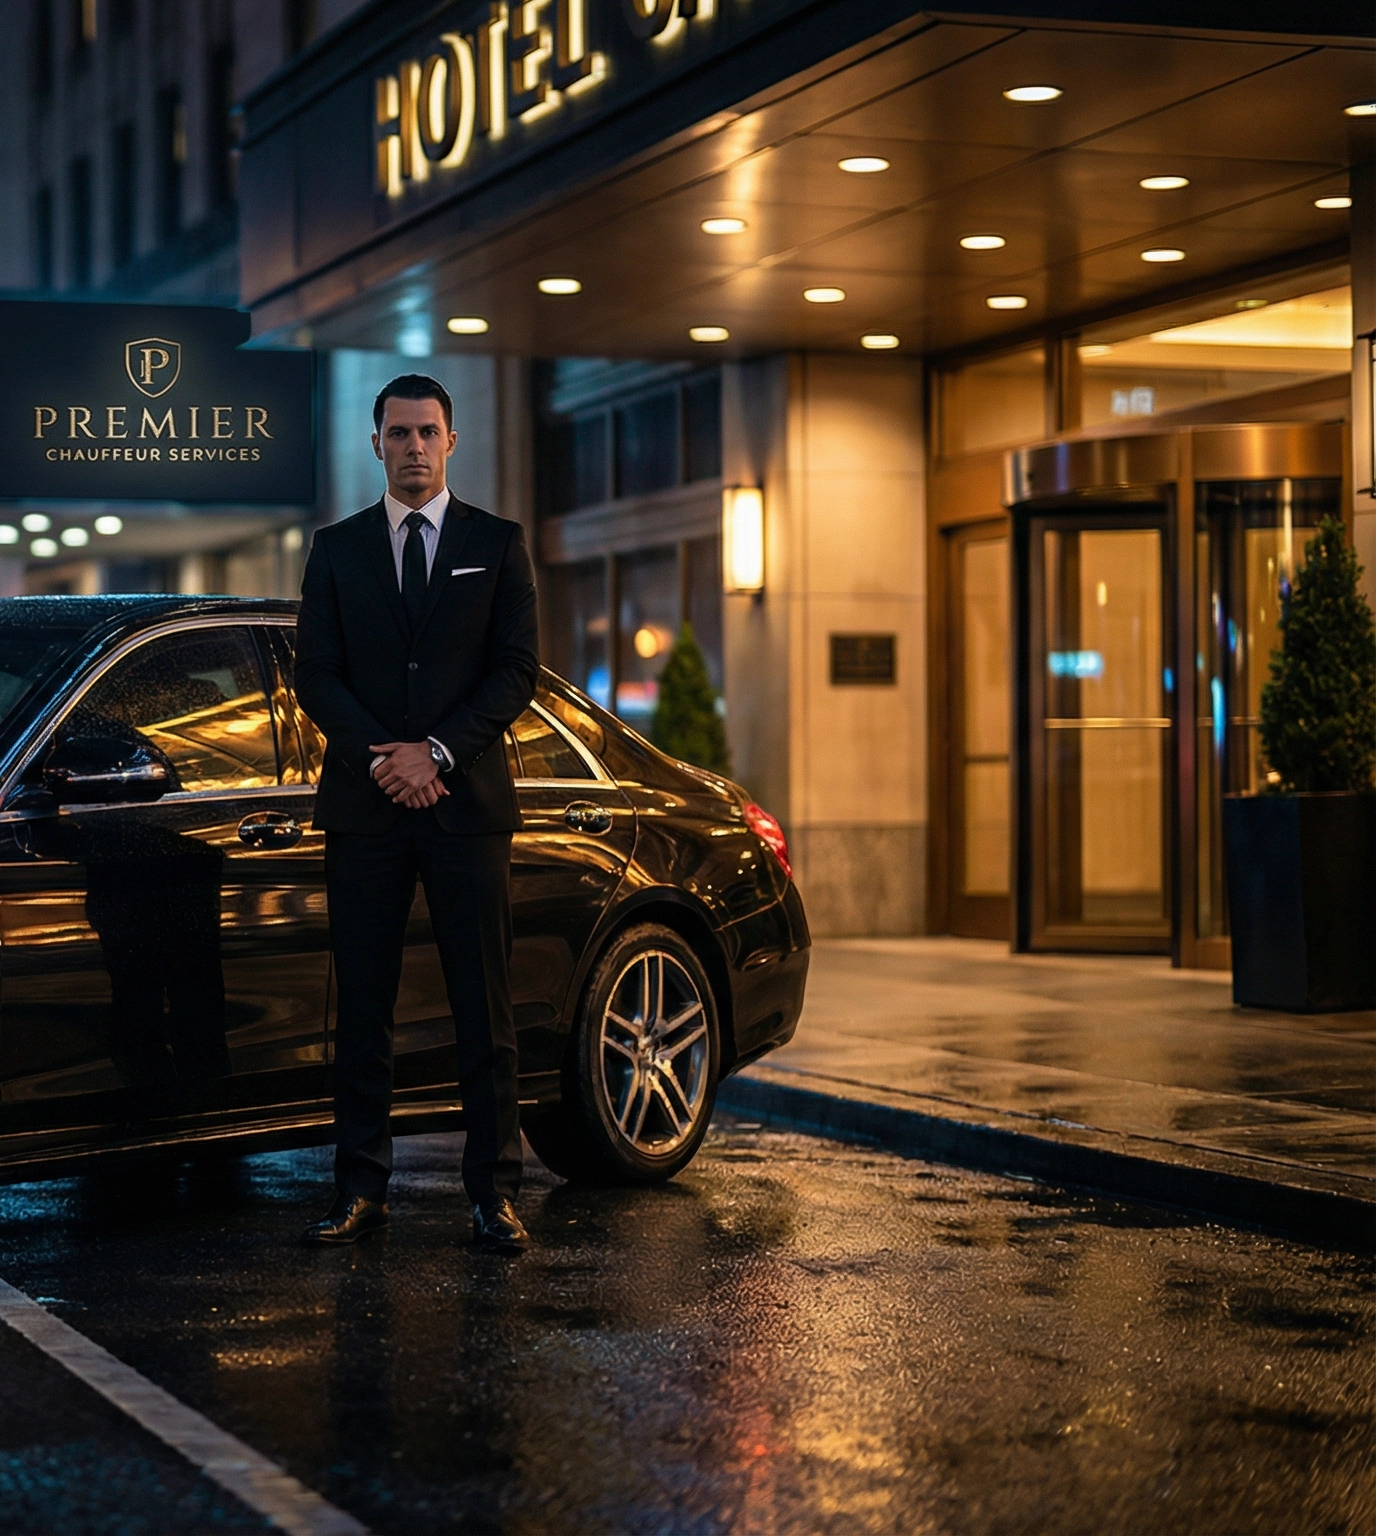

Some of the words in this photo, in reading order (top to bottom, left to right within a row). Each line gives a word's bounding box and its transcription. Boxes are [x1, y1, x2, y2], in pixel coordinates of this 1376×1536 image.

[376, 0, 607, 197] HOTEL
[140, 348, 170, 385] P
[33, 406, 274, 439] PREMIER
[45, 447, 161, 462] CHAUFFEUR
[168, 447, 261, 462] SERVICES
